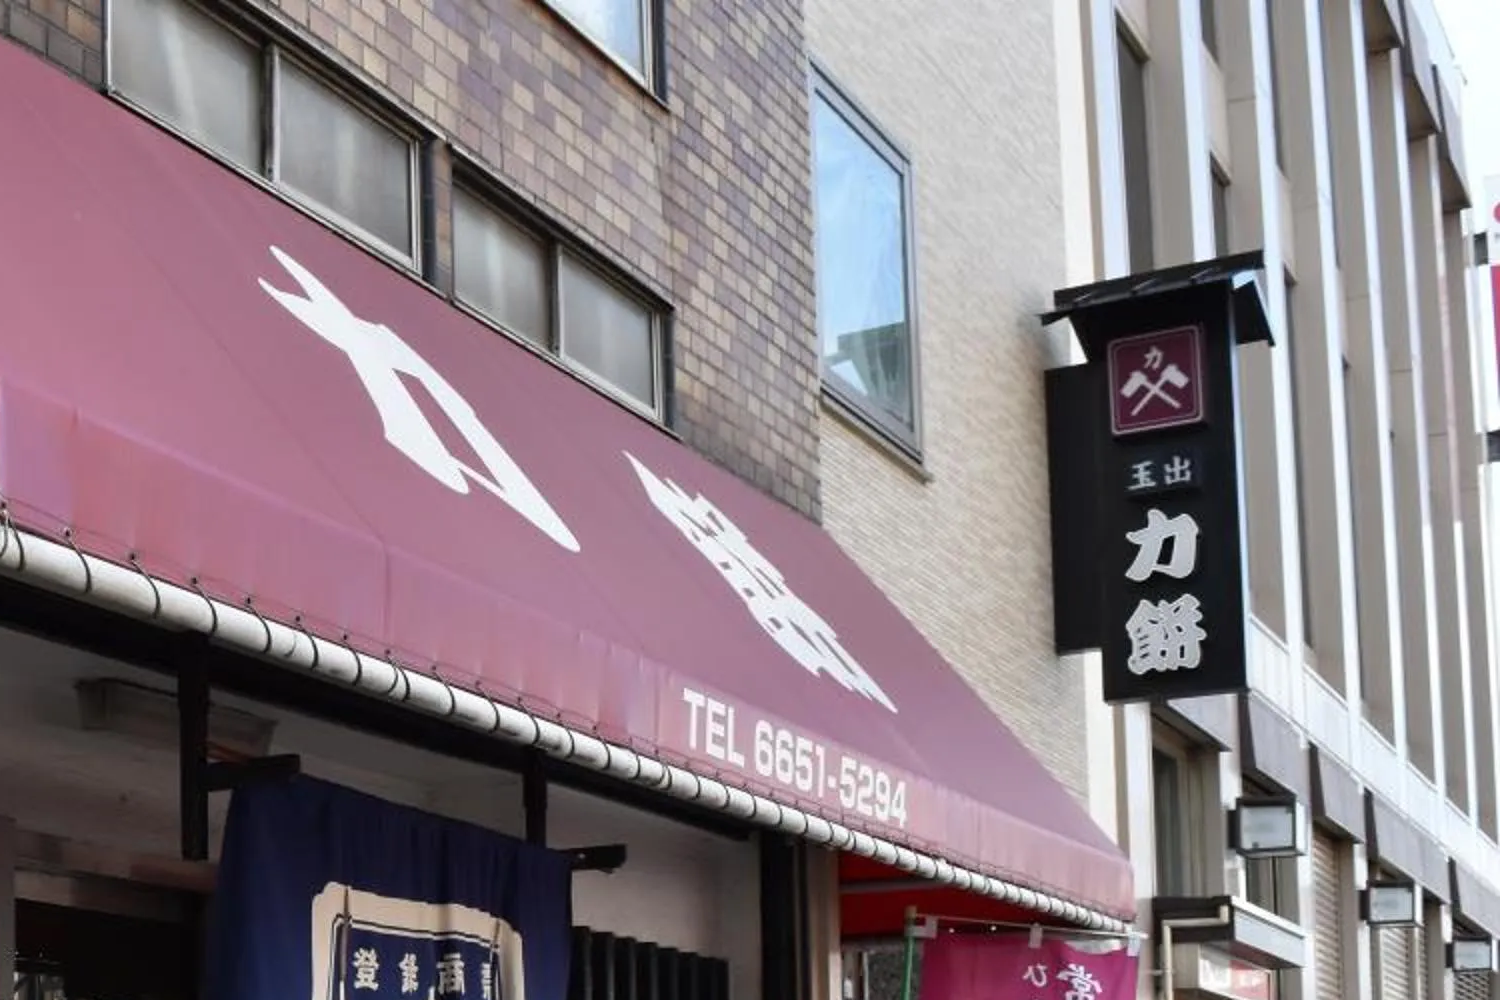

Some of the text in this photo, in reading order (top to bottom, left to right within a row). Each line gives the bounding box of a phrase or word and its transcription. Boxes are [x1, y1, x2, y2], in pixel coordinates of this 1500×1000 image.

[1127, 456, 1192, 492] 玉出
[683, 688, 908, 828] TEL 6651-5294
